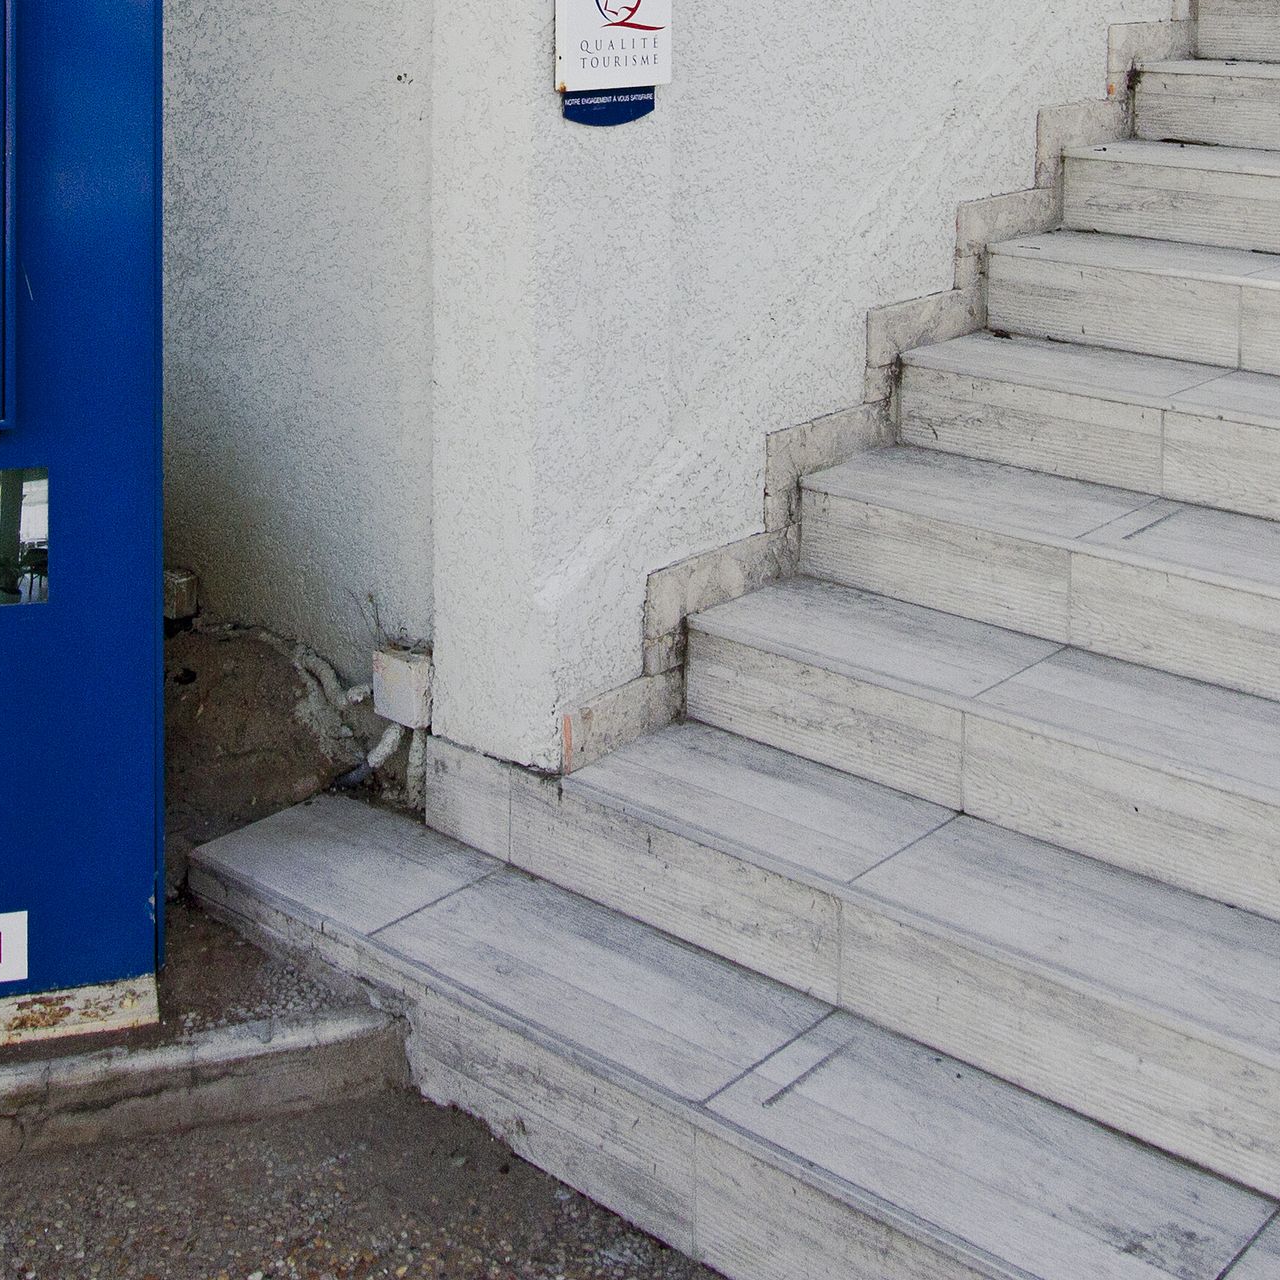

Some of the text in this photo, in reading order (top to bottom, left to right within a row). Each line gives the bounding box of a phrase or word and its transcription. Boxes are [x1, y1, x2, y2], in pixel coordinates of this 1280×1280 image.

[580, 35, 659, 54] QUALITÉ
[580, 54, 659, 69] TOURISME
[564, 97, 581, 106] NOTRE
[581, 96, 612, 105] ENGAGEMENT
[617, 94, 630, 102] VOUS
